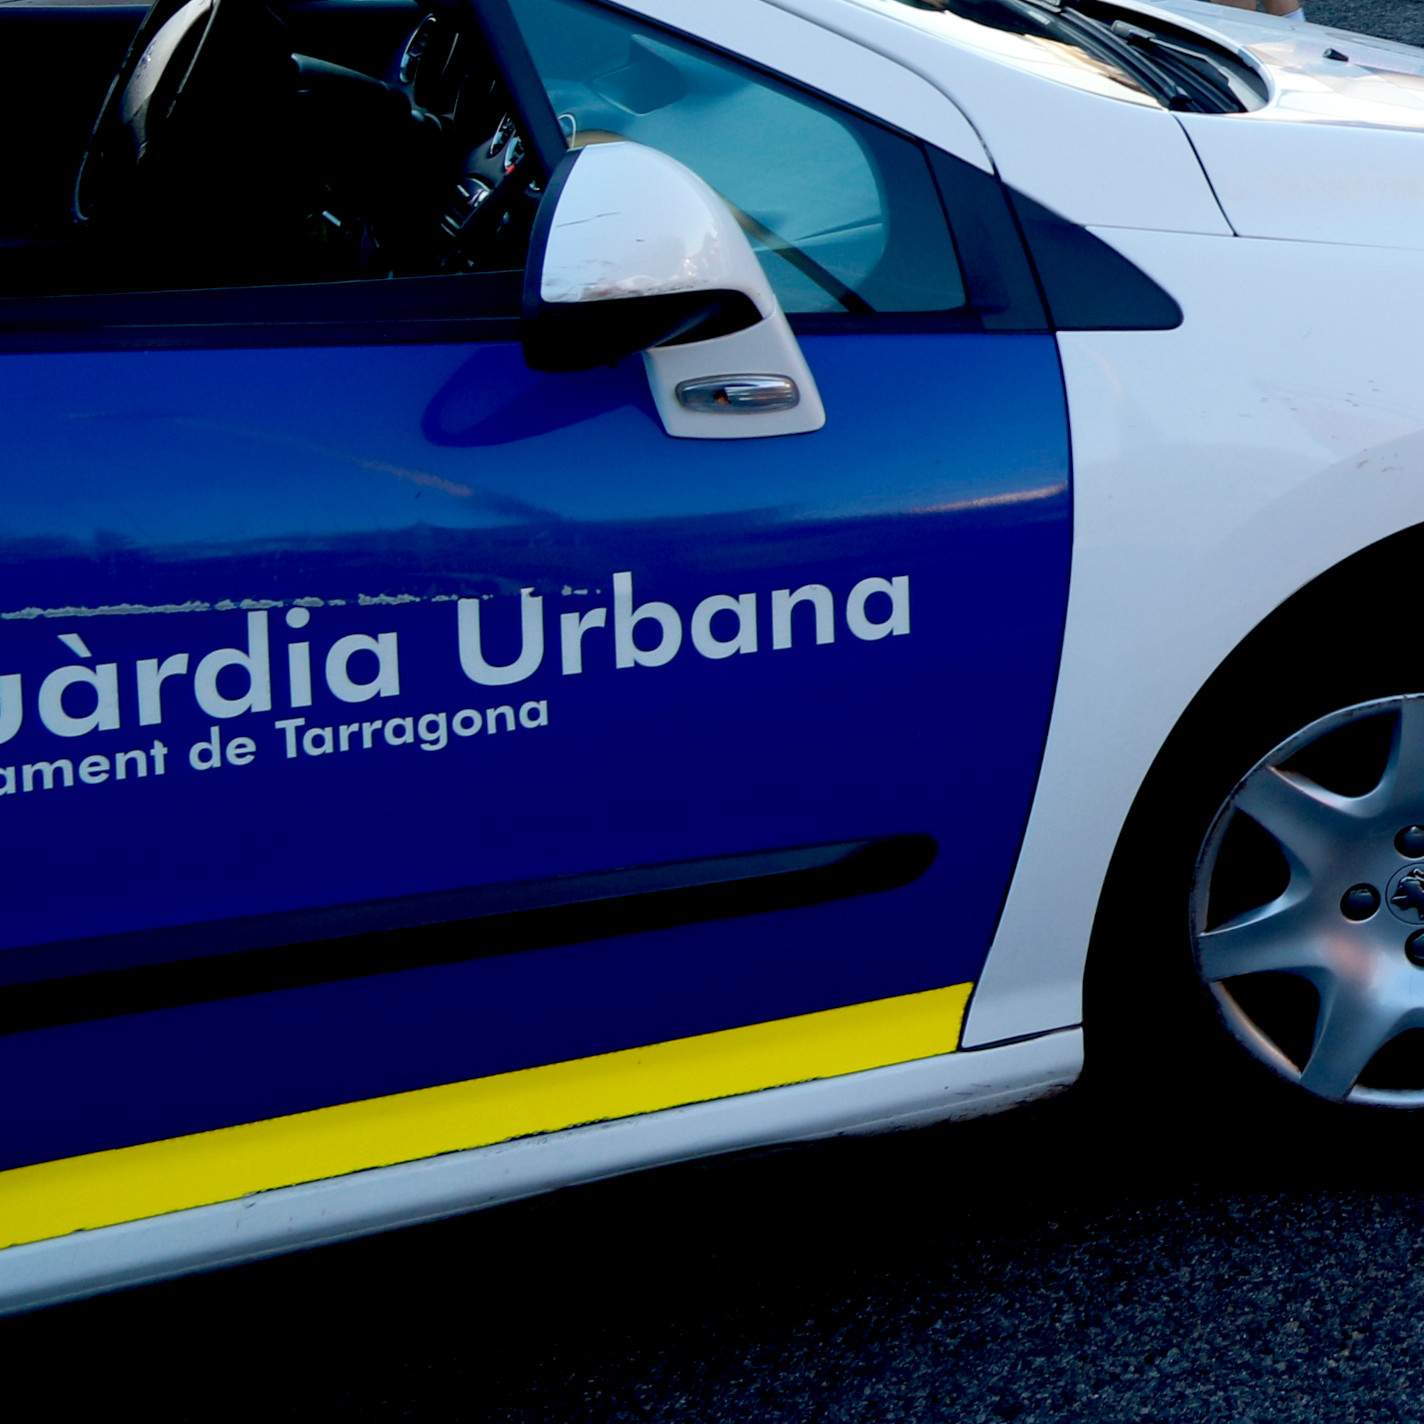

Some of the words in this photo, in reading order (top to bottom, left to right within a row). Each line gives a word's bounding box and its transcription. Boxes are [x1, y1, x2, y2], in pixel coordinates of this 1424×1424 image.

[456, 570, 912, 687] Urbana
[189, 725, 257, 771] de
[275, 698, 551, 762] Tarragona
